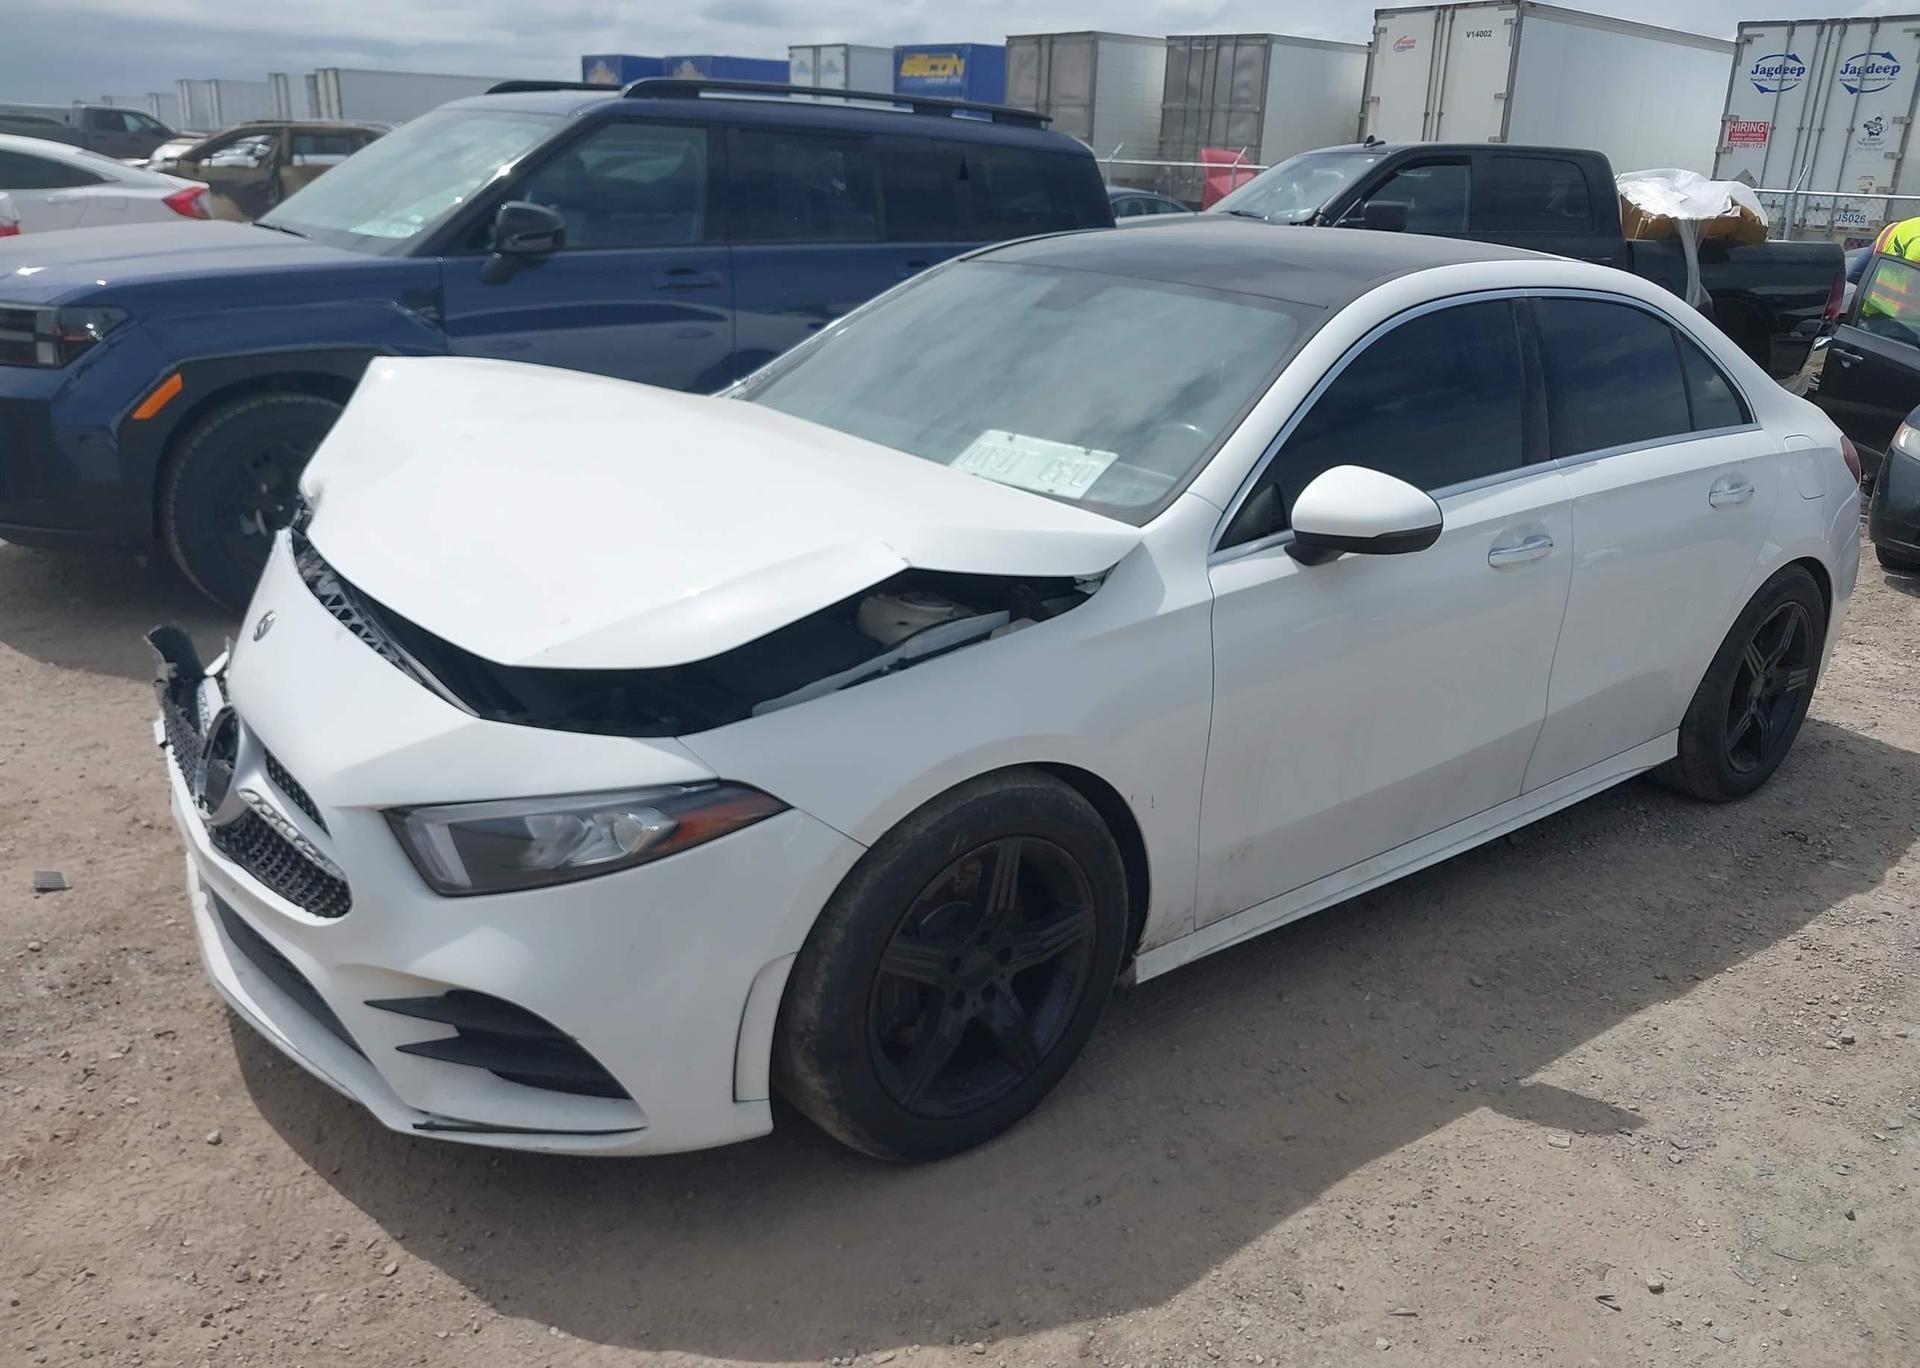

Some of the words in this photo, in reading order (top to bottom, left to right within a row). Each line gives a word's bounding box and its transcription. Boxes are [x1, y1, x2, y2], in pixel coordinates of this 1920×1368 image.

[1466, 30, 1493, 38] V14002
[1751, 64, 1806, 77] Jagdeep
[1840, 63, 1901, 77] Jagdeep
[1731, 122, 1769, 133] HIRING!
[1835, 213, 1866, 223] JS026
